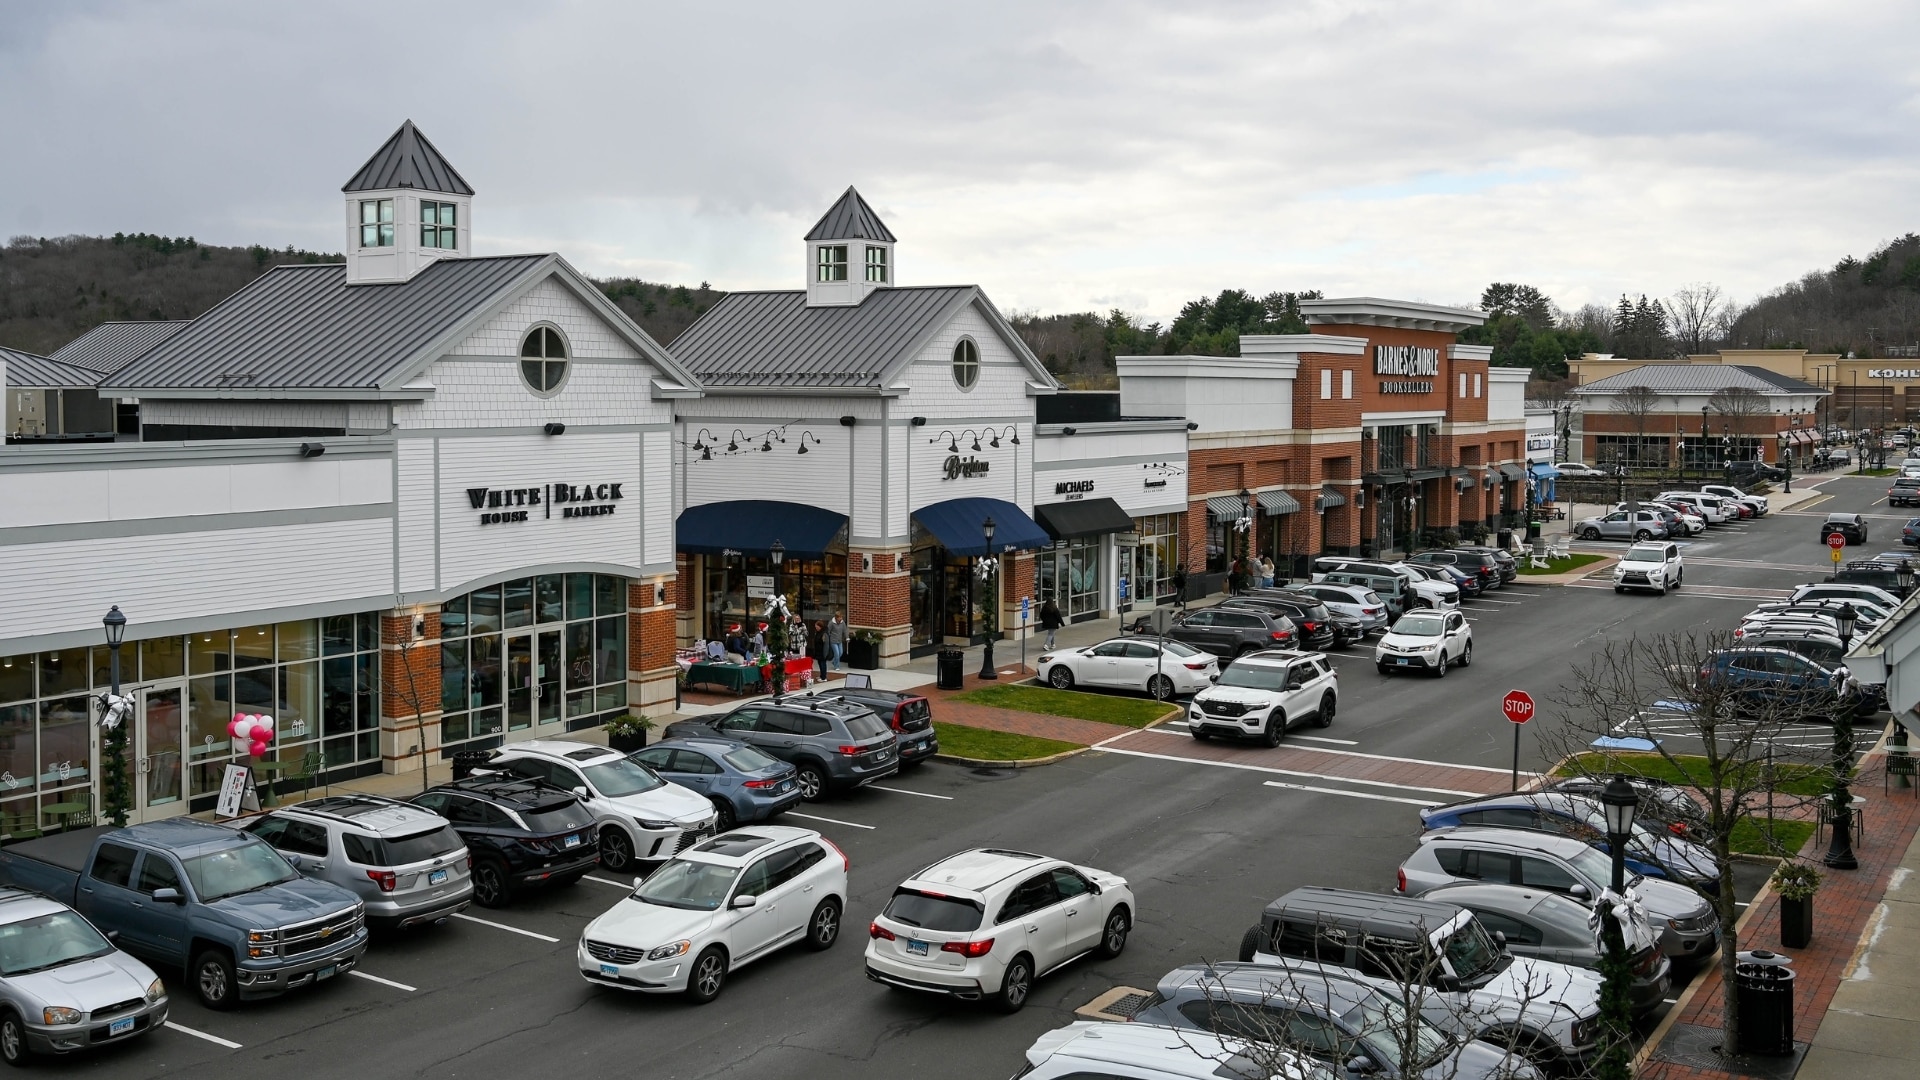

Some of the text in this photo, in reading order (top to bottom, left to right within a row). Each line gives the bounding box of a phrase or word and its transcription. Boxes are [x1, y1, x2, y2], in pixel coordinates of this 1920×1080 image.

[1383, 381, 1434, 393] BOOKSELLERS
[942, 454, 989, 480] Brighton
[1055, 480, 1094, 495] MICHAELS
[466, 483, 624, 509] WHITE BLACK
[481, 504, 616, 525] HOUSE MARKET
[1829, 537, 1844, 545] STOP
[1505, 699, 1532, 715] STOP
[491, 725, 502, 733] 900
